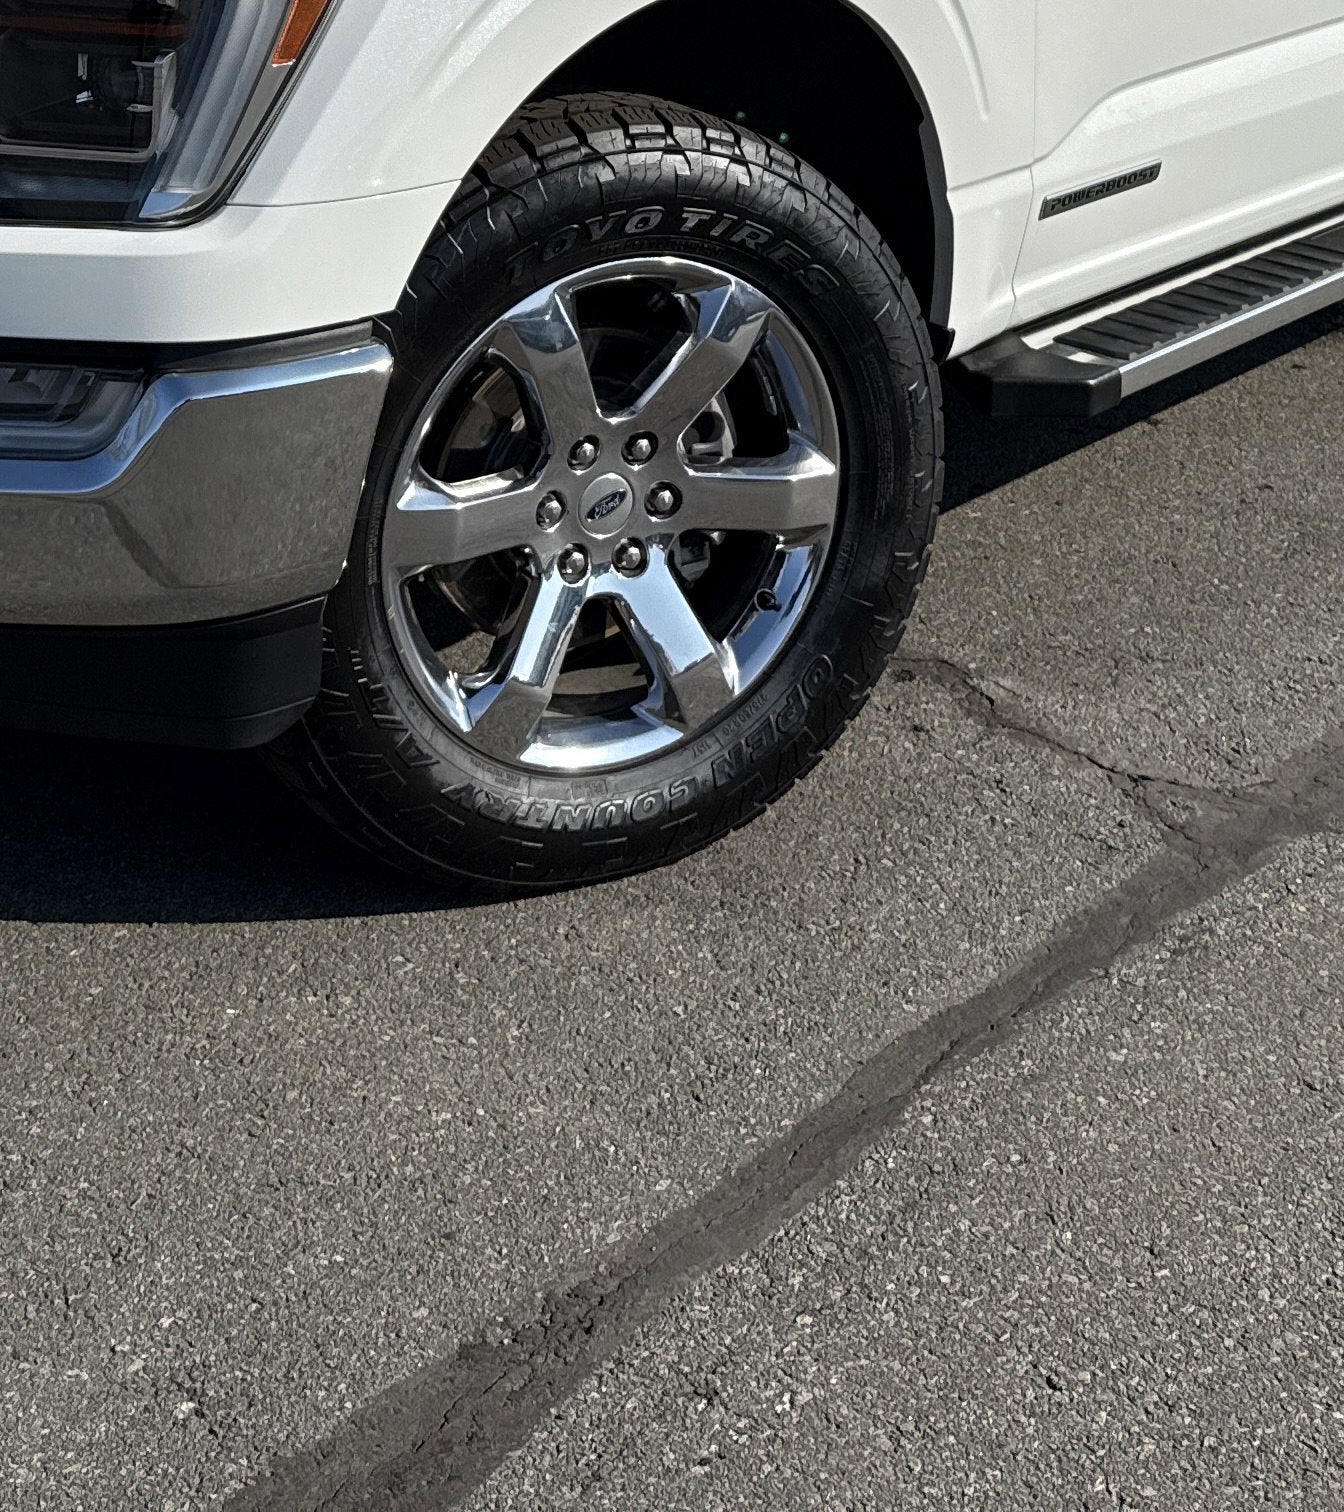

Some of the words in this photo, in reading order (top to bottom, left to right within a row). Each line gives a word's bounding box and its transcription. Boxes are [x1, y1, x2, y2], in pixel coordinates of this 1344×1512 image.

[1050, 168, 1157, 211] POWERBOOST
[504, 205, 665, 286] TOYO
[679, 206, 841, 296] TIRES
[711, 654, 833, 789] OPEN
[441, 776, 698, 832] COUNTRY
